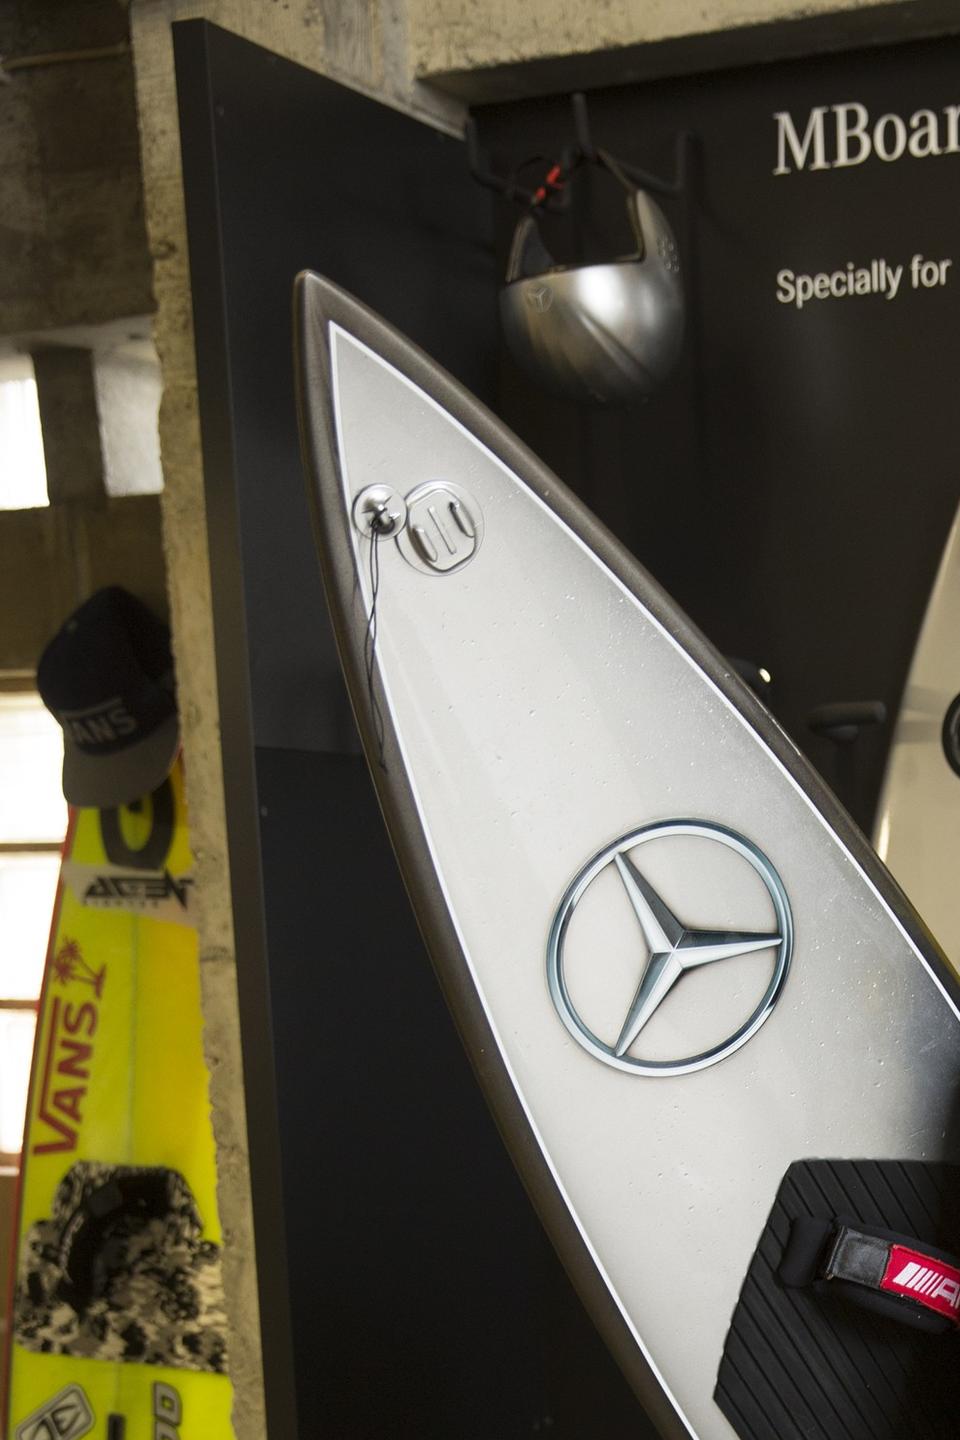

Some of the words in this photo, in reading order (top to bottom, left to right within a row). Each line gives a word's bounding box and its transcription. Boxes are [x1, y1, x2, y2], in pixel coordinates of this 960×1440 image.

[775, 261, 904, 309] Specially
[911, 254, 952, 289] for
[33, 996, 99, 1158] VANS
